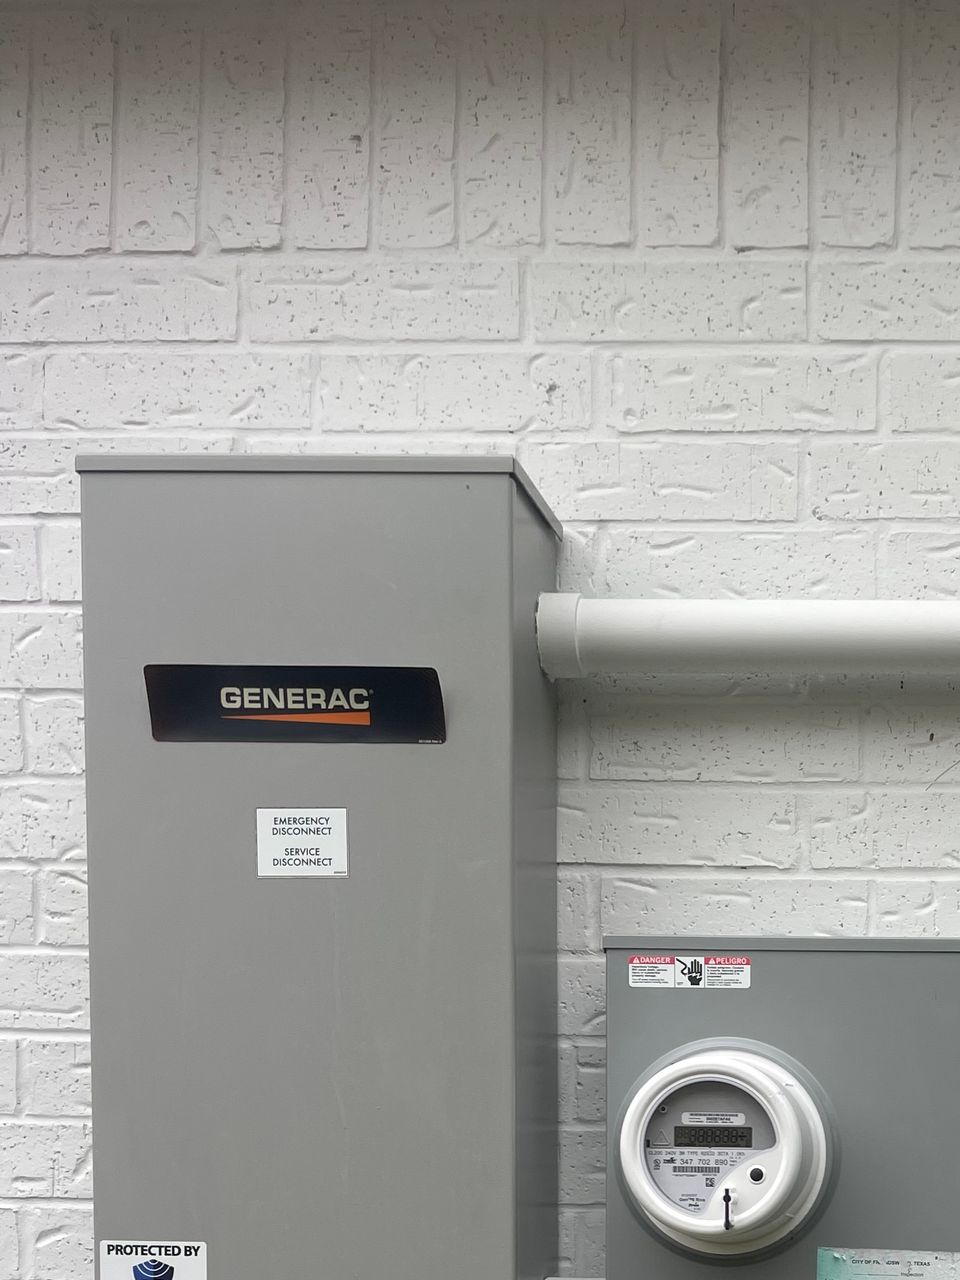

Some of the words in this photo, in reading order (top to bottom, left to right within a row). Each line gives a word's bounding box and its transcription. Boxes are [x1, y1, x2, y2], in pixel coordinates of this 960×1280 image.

[220, 687, 370, 710] GENERAC
[273, 817, 330, 826] EMERGENCY
[272, 827, 332, 836] DISCONNECT
[284, 848, 320, 856] SERVICE
[272, 858, 332, 867] DISCONNECT
[107, 1244, 181, 1256] PROTECTED
[184, 1245, 201, 1257] BY
